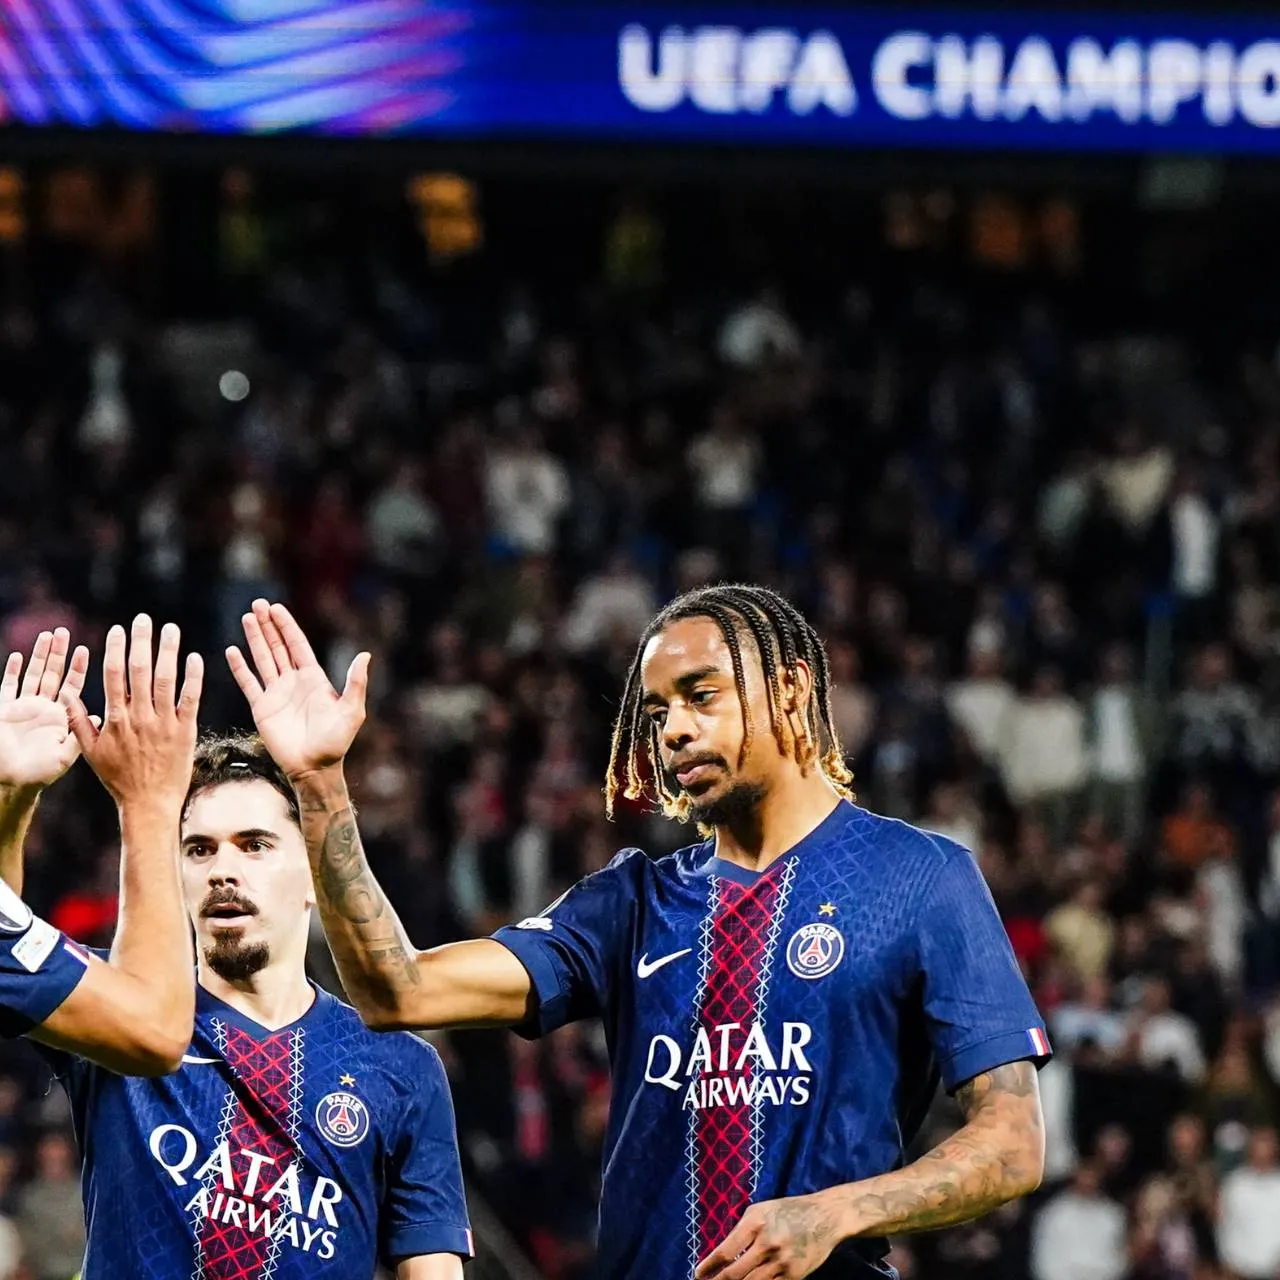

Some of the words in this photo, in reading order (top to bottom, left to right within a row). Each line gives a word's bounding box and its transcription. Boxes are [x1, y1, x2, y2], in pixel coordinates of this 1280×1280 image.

[618, 26, 858, 114] UEFA
[644, 1022, 813, 1090] QATAR
[682, 1076, 811, 1111] AIRWAYS
[149, 1124, 343, 1228] QATAR
[184, 1187, 337, 1260] AIRWAYS
